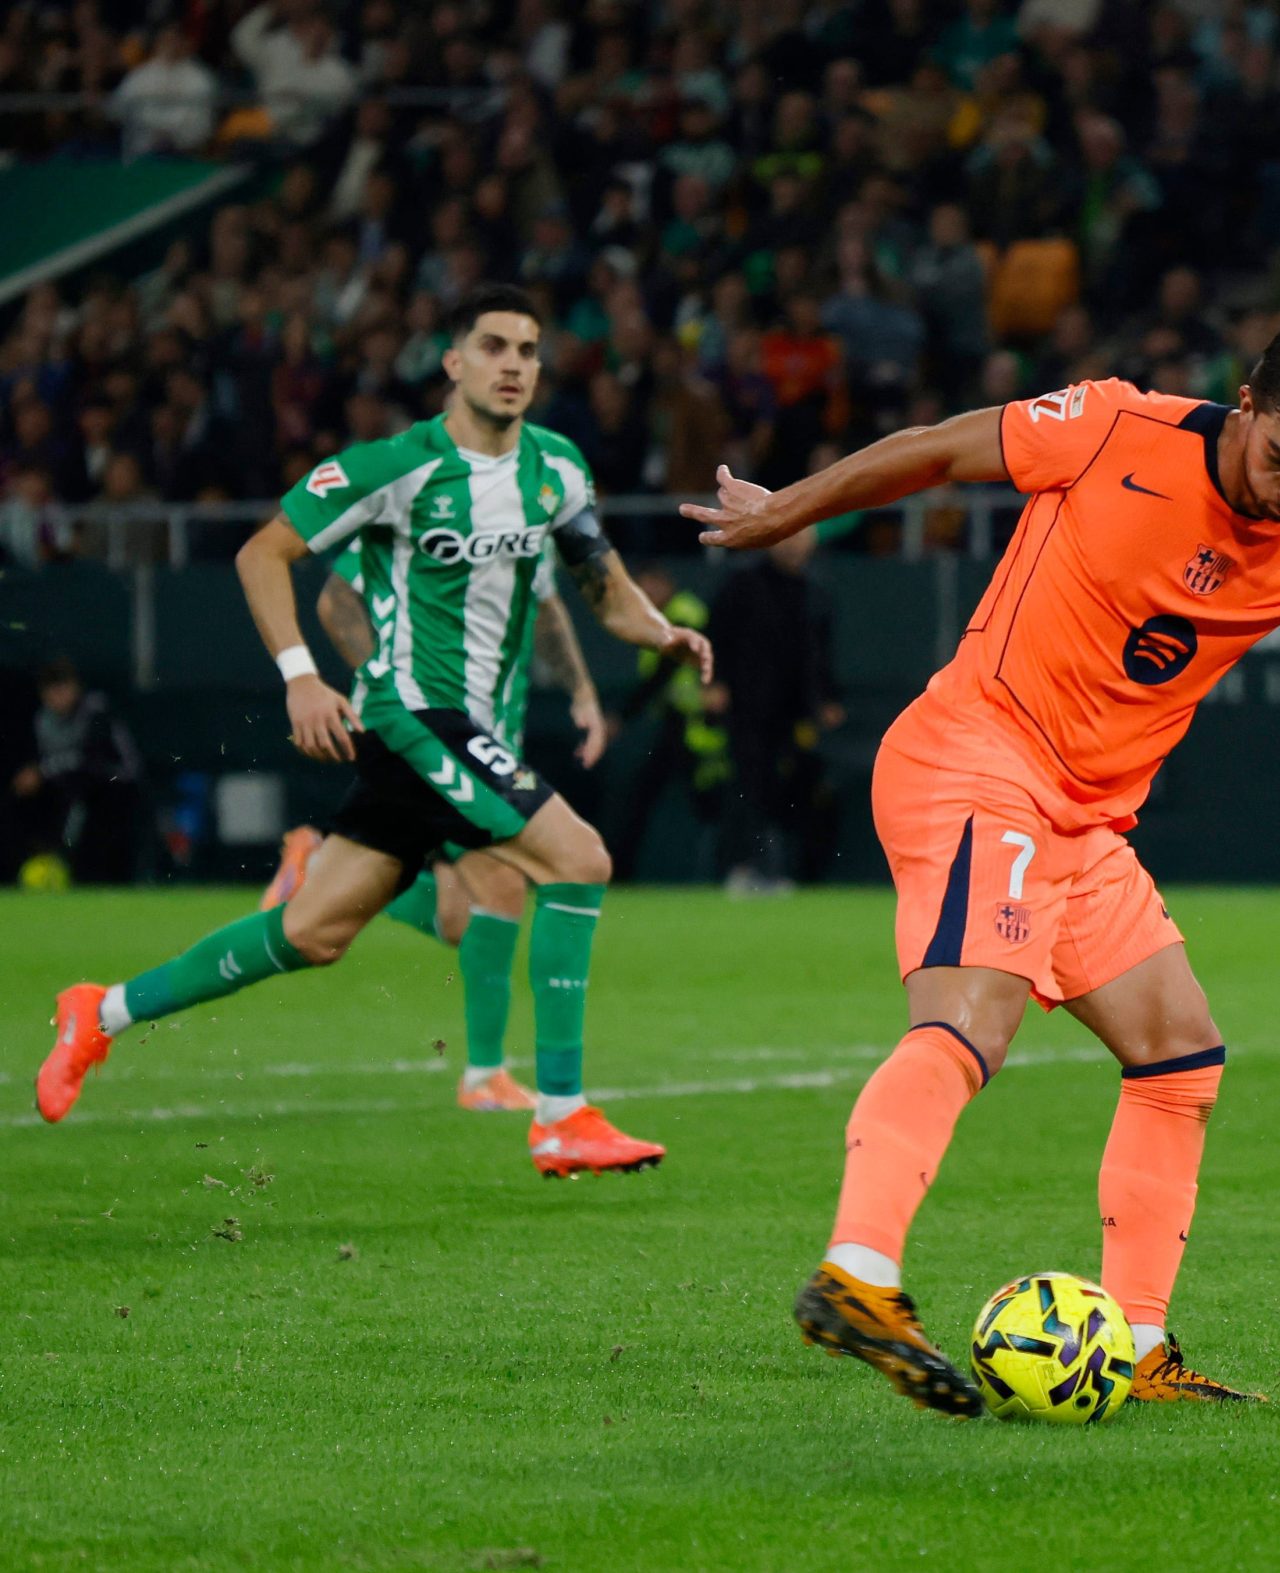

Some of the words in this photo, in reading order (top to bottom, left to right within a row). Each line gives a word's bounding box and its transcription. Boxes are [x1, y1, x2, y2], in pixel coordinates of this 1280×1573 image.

[471, 532, 543, 558] GRE
[466, 734, 518, 776] 5
[1000, 830, 1037, 900] 7
